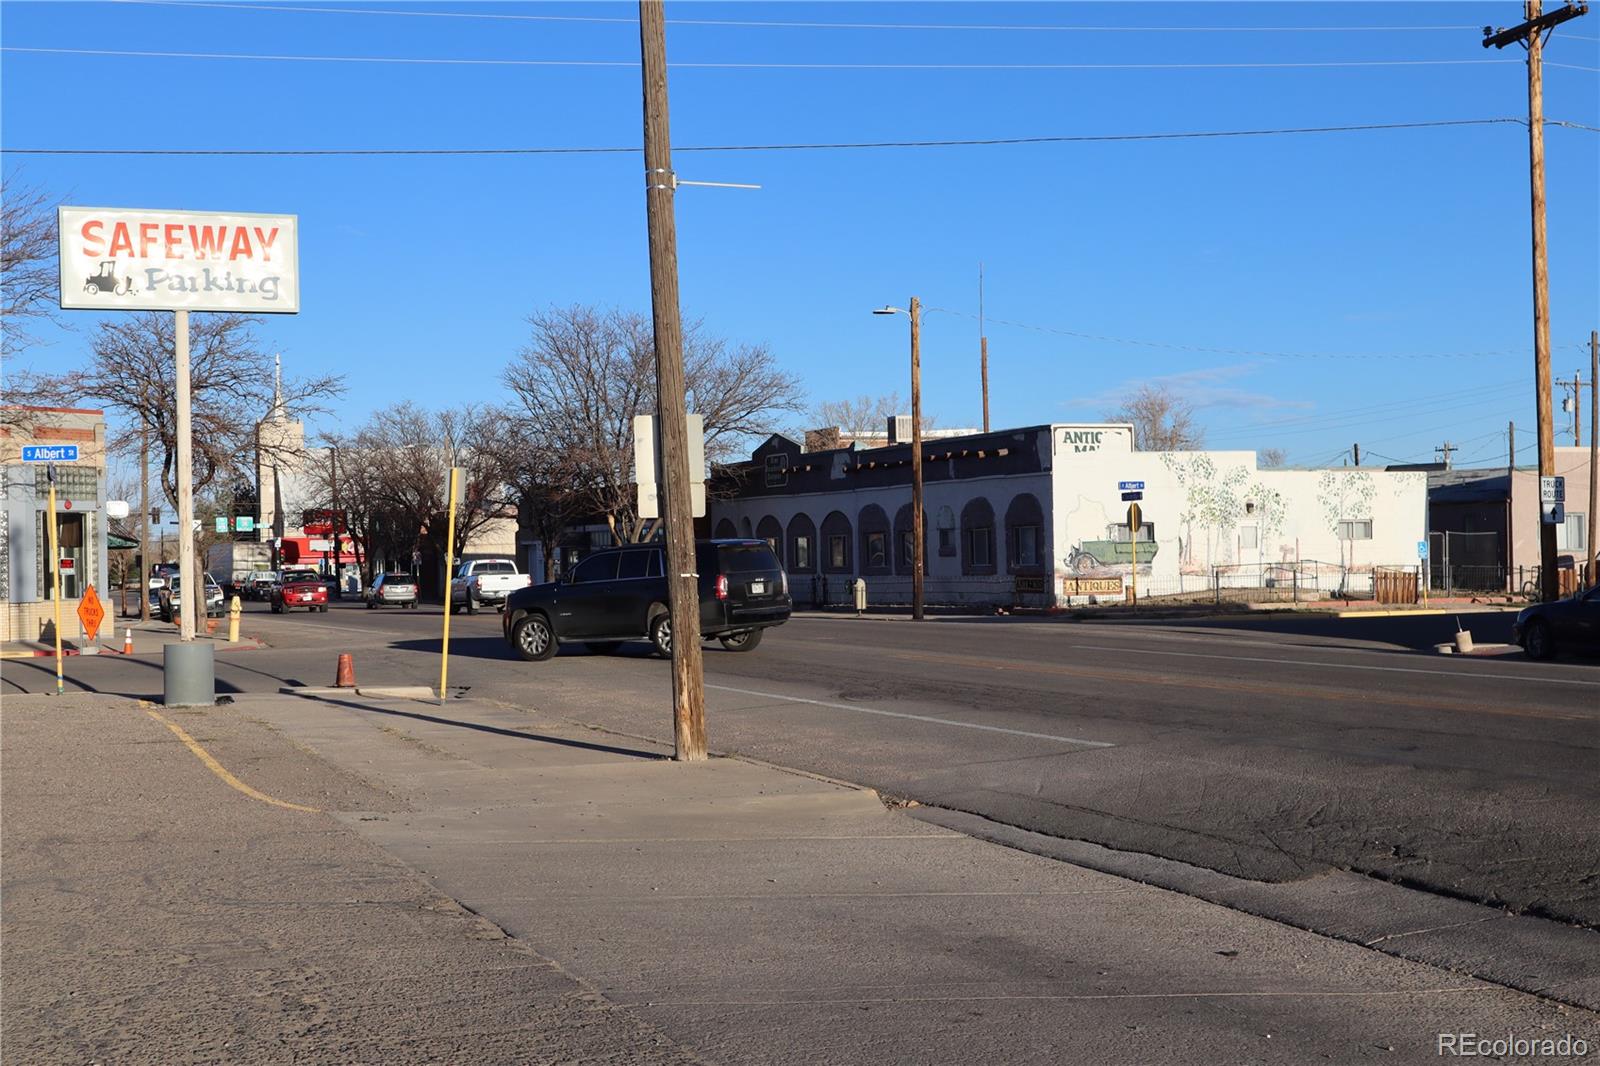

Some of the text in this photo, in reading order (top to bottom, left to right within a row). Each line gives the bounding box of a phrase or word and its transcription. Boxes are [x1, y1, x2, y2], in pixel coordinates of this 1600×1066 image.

[81, 220, 279, 262] SAFEWAY
[144, 267, 281, 301] Parking
[34, 447, 65, 459] Albert
[1543, 480, 1563, 489] TRUCK
[1543, 490, 1563, 499] ROUTE
[1068, 581, 1120, 591] ANTIQUES
[84, 607, 99, 616] TRUCKS
